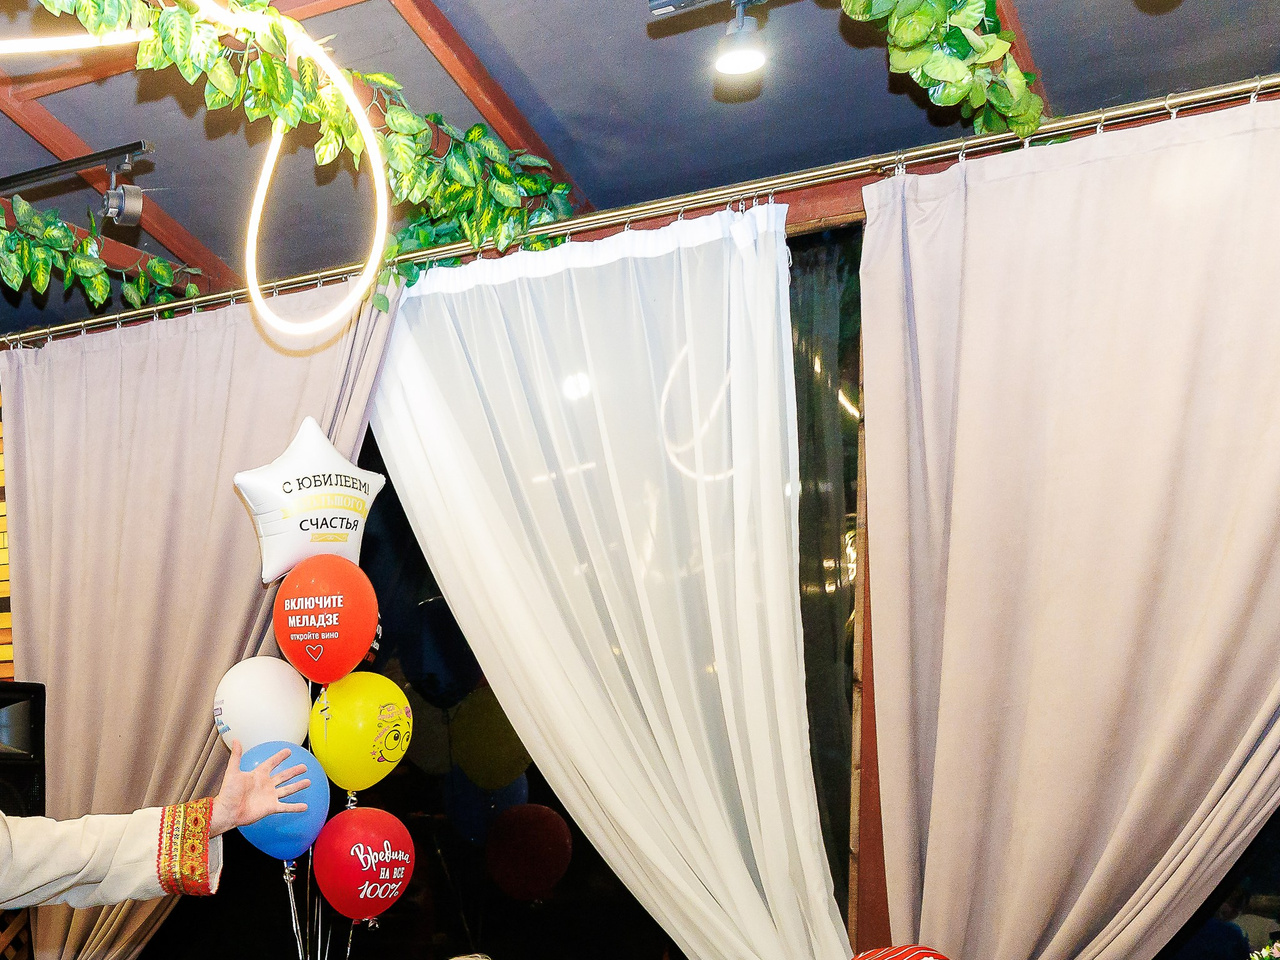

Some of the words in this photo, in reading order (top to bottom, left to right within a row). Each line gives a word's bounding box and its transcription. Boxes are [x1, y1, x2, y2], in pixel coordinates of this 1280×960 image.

[282, 481, 293, 494] С
[296, 473, 370, 496] ЮБИЛЕЕМ!
[299, 516, 359, 532] СЧАСТЬЯ
[284, 595, 344, 611] ВКЛЮЧИТЕ
[288, 613, 340, 628] МЕЛАДЗЕ
[290, 631, 320, 642] откройте
[320, 631, 339, 640] вино
[350, 839, 411, 871] Вредина
[379, 867, 390, 880] НА
[392, 866, 405, 879] ВСЕ
[357, 880, 403, 899] 100%
